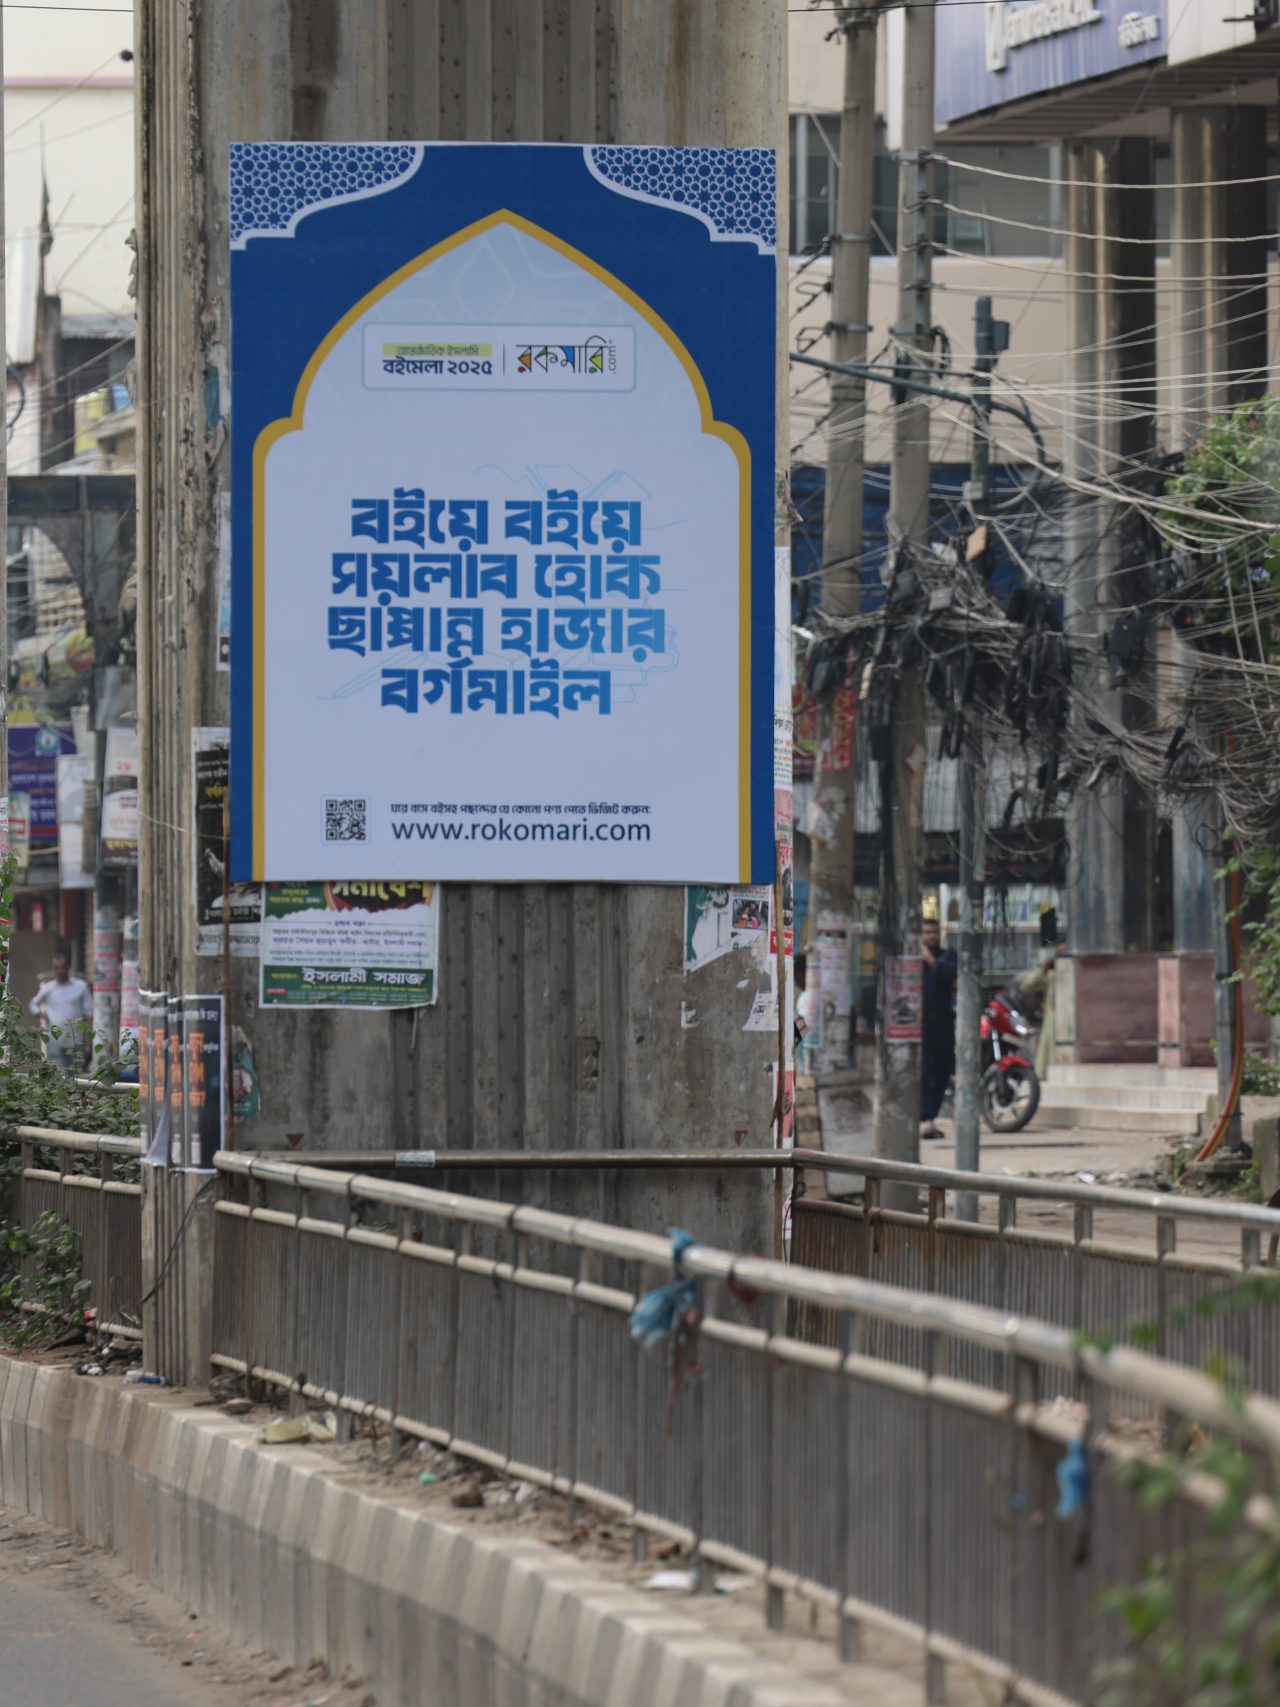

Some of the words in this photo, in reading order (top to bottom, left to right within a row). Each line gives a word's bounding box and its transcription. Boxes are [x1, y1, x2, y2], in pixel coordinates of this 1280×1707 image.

[382, 357, 443, 375] বইমেলা
[447, 359, 492, 375] ২০২৫
[516, 335, 608, 374] রকমারি
[351, 487, 488, 552] বইয়ে
[504, 489, 641, 553] বইয়ে
[332, 553, 517, 606] সয়লাব
[534, 554, 661, 604] হোক
[327, 606, 483, 659] ছাপ্পান্ন
[501, 608, 665, 664] হাজার
[381, 657, 611, 720] বর্গমাইল
[588, 801, 618, 814] ভিজিট
[391, 818, 651, 841] www.rokomari.com
[301, 967, 366, 984] ইসলামী
[372, 971, 427, 986] সমাজ
